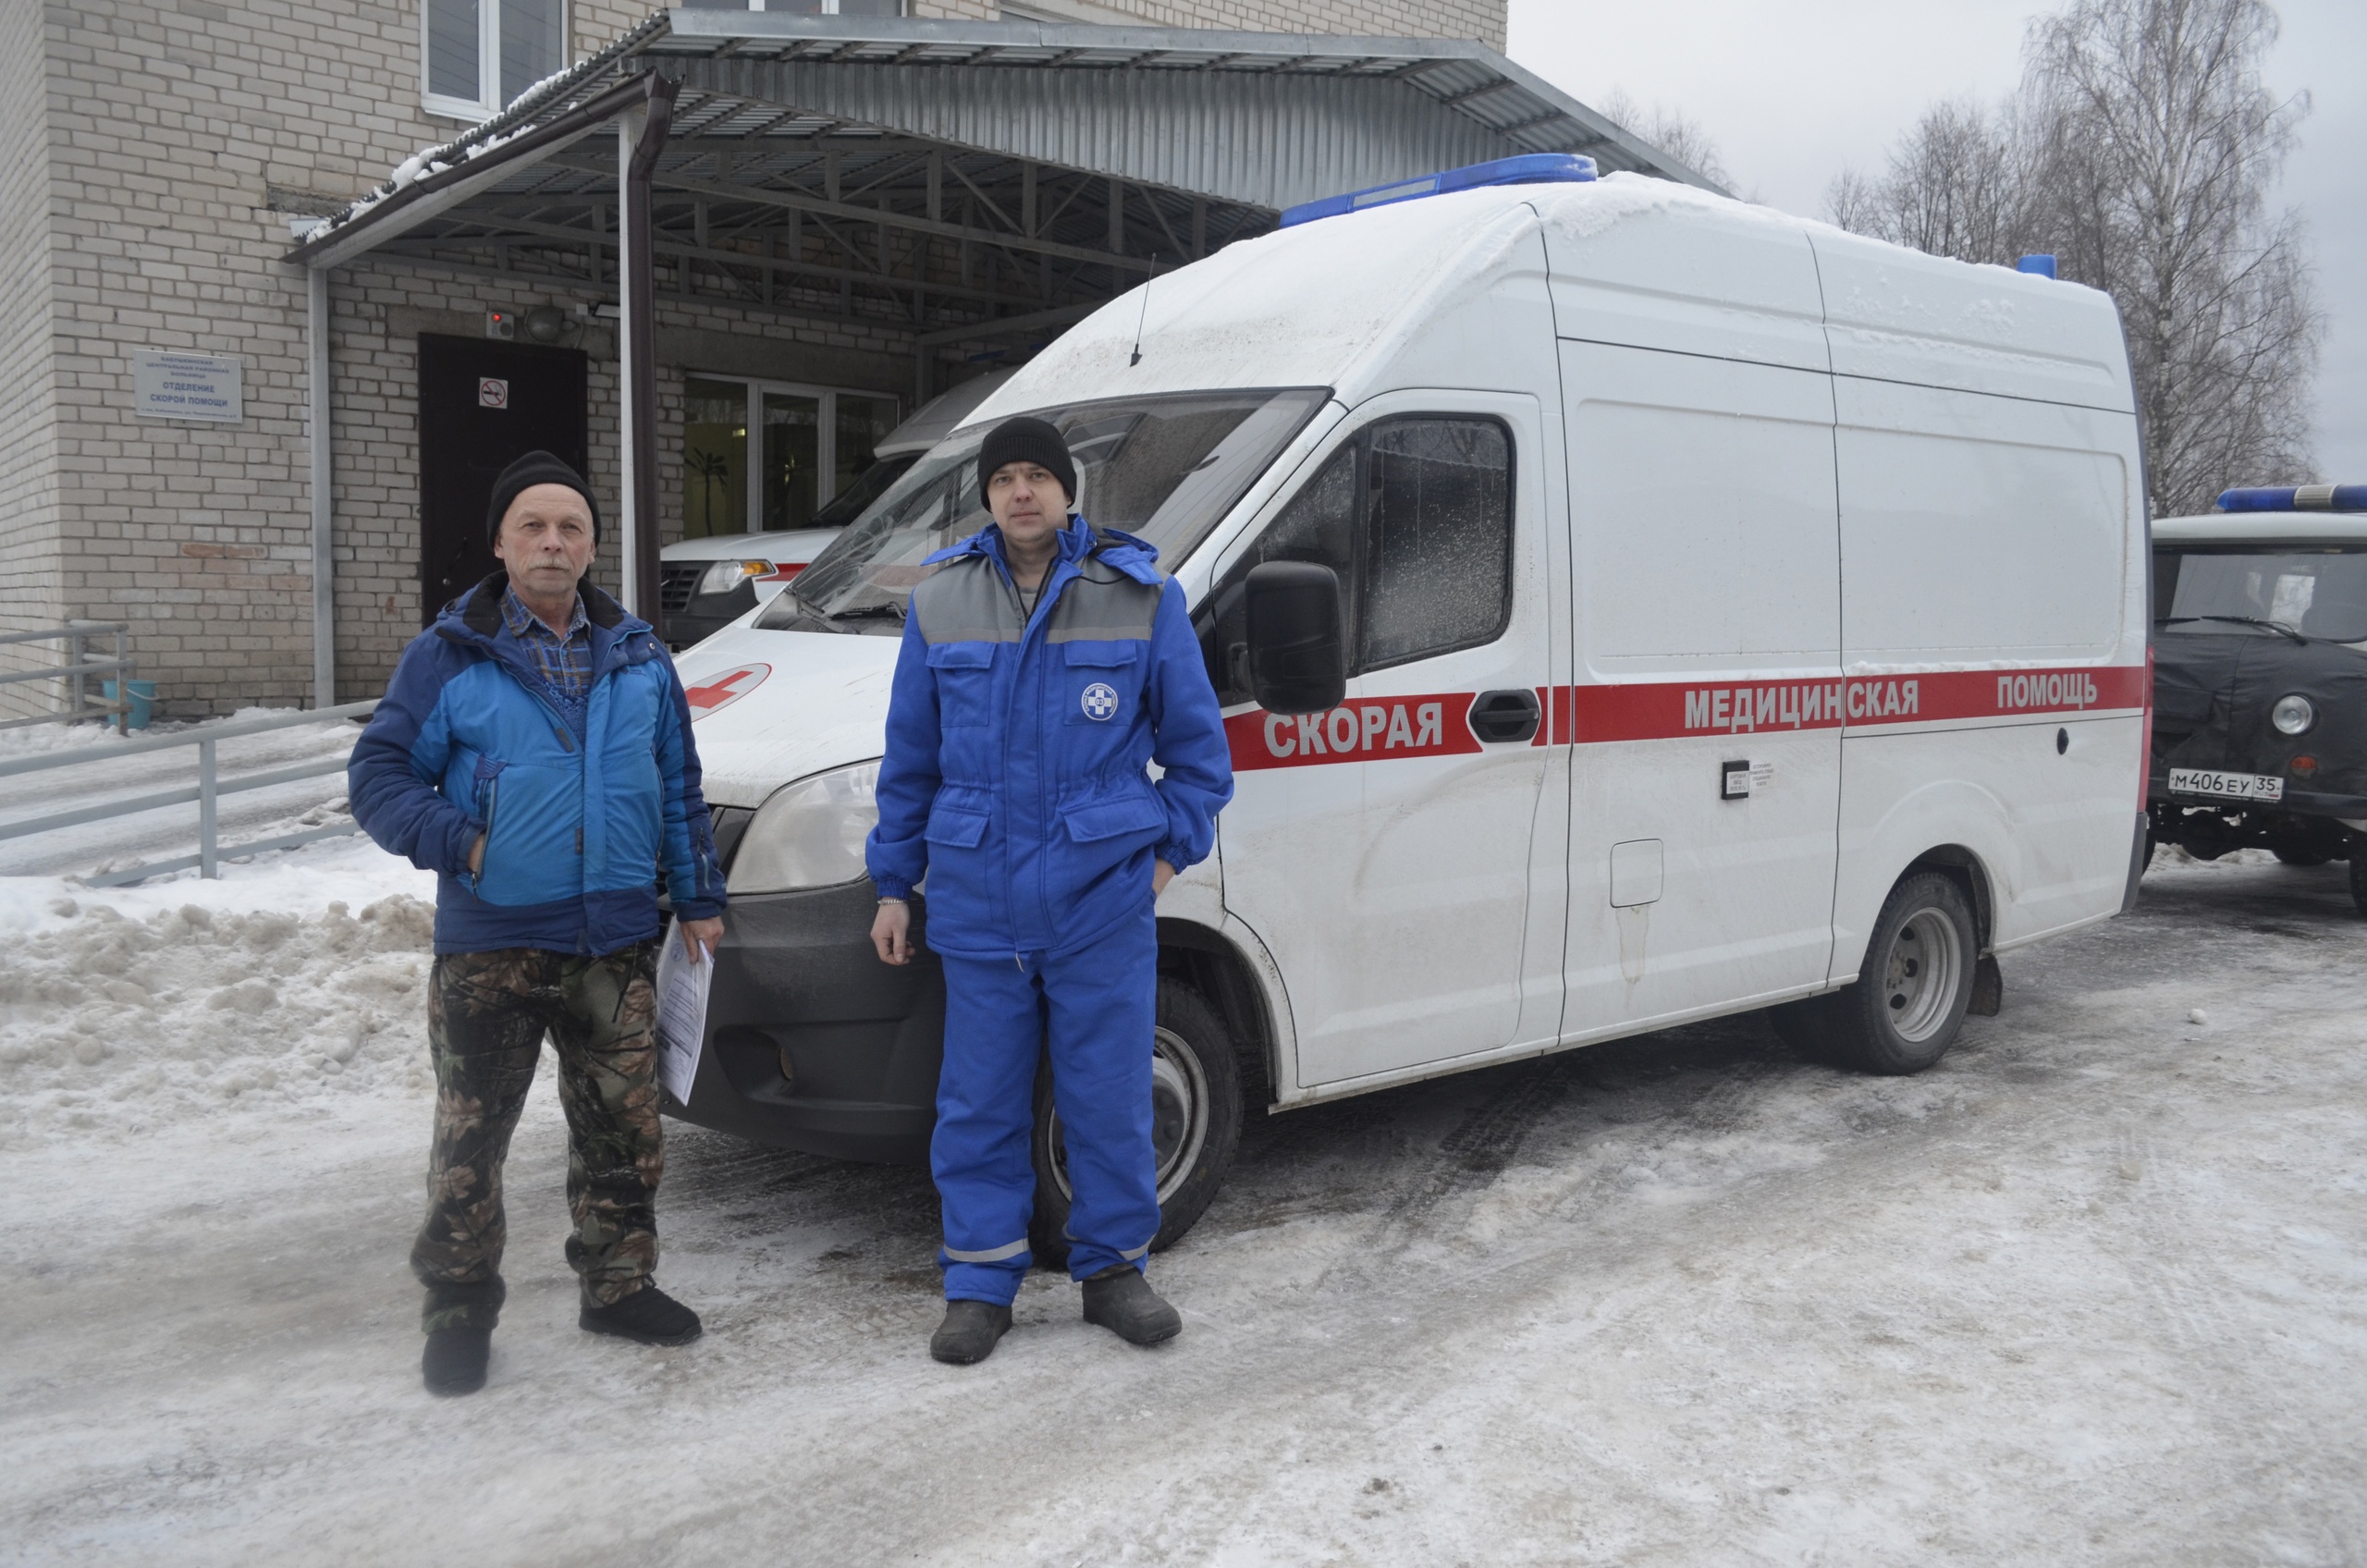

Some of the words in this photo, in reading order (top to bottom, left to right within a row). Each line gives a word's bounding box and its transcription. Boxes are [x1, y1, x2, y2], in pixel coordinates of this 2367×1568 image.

[146, 362, 194, 371] ЦЕНТРАЛЬНАЯ
[170, 371, 206, 379] БОЛЬНИЦА
[163, 381, 215, 393] ОТДЕЛЕНИЕ
[150, 393, 186, 404] СКОРОЙ
[188, 397, 228, 408] ПОМОЩИ
[1263, 703, 1442, 758] СКОРАЯ
[1684, 680, 1919, 734] МЕДИЦИНСКАЯ
[1997, 672, 2098, 710] ПОМОЩЬ
[2256, 777, 2276, 791] 35
